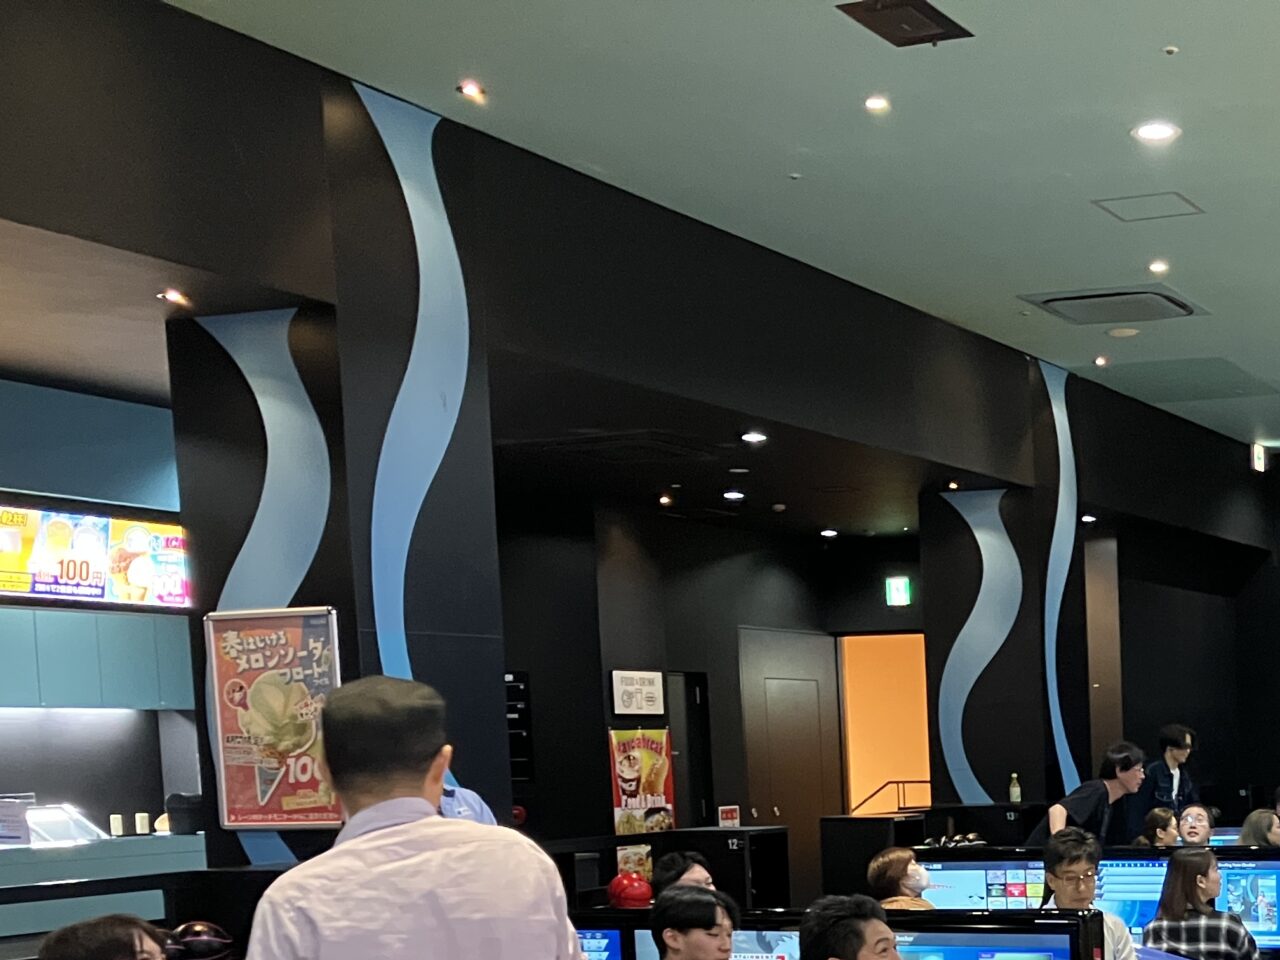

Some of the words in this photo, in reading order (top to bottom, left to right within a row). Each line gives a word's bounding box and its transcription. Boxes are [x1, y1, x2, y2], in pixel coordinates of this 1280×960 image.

[236, 637, 325, 673] メロンソーダ
[279, 662, 323, 685] フロート
[728, 839, 738, 849] 12
